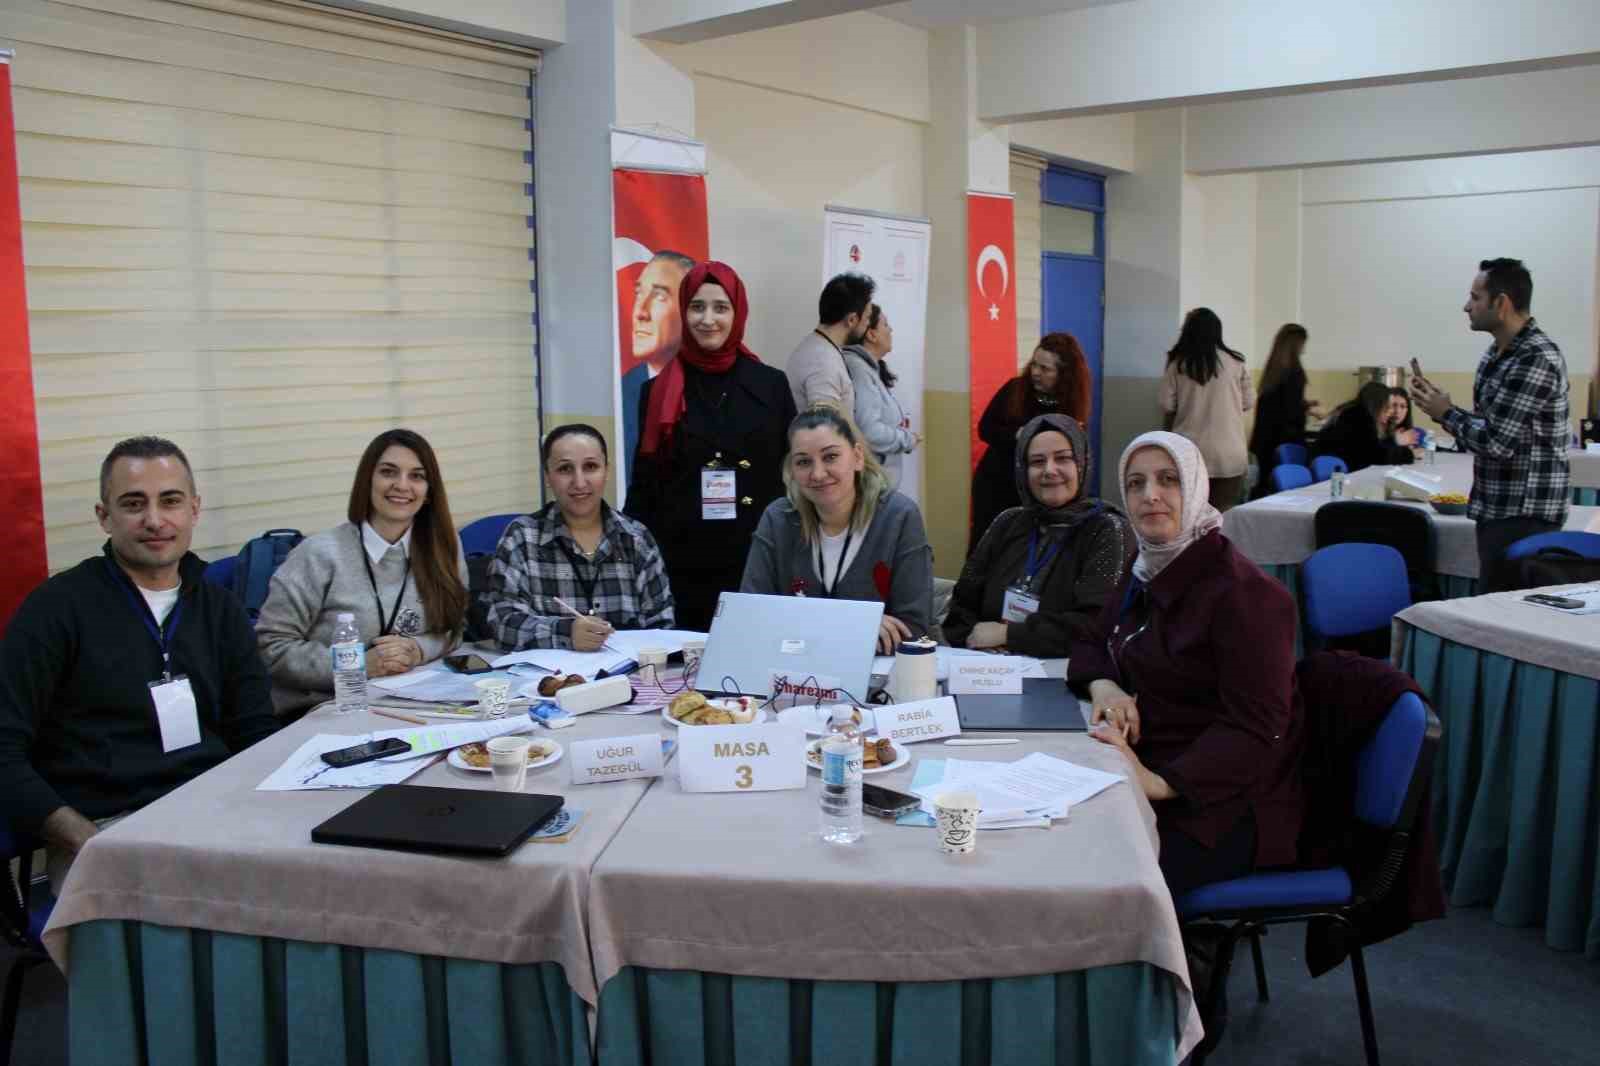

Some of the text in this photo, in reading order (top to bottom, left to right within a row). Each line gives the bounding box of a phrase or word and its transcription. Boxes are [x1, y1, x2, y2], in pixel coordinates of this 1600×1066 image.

[897, 707, 934, 722] RABİA
[596, 744, 635, 759] UĞUR
[713, 741, 769, 759] MASA
[586, 760, 645, 776] TAZEGÜL
[735, 765, 753, 789] 3
